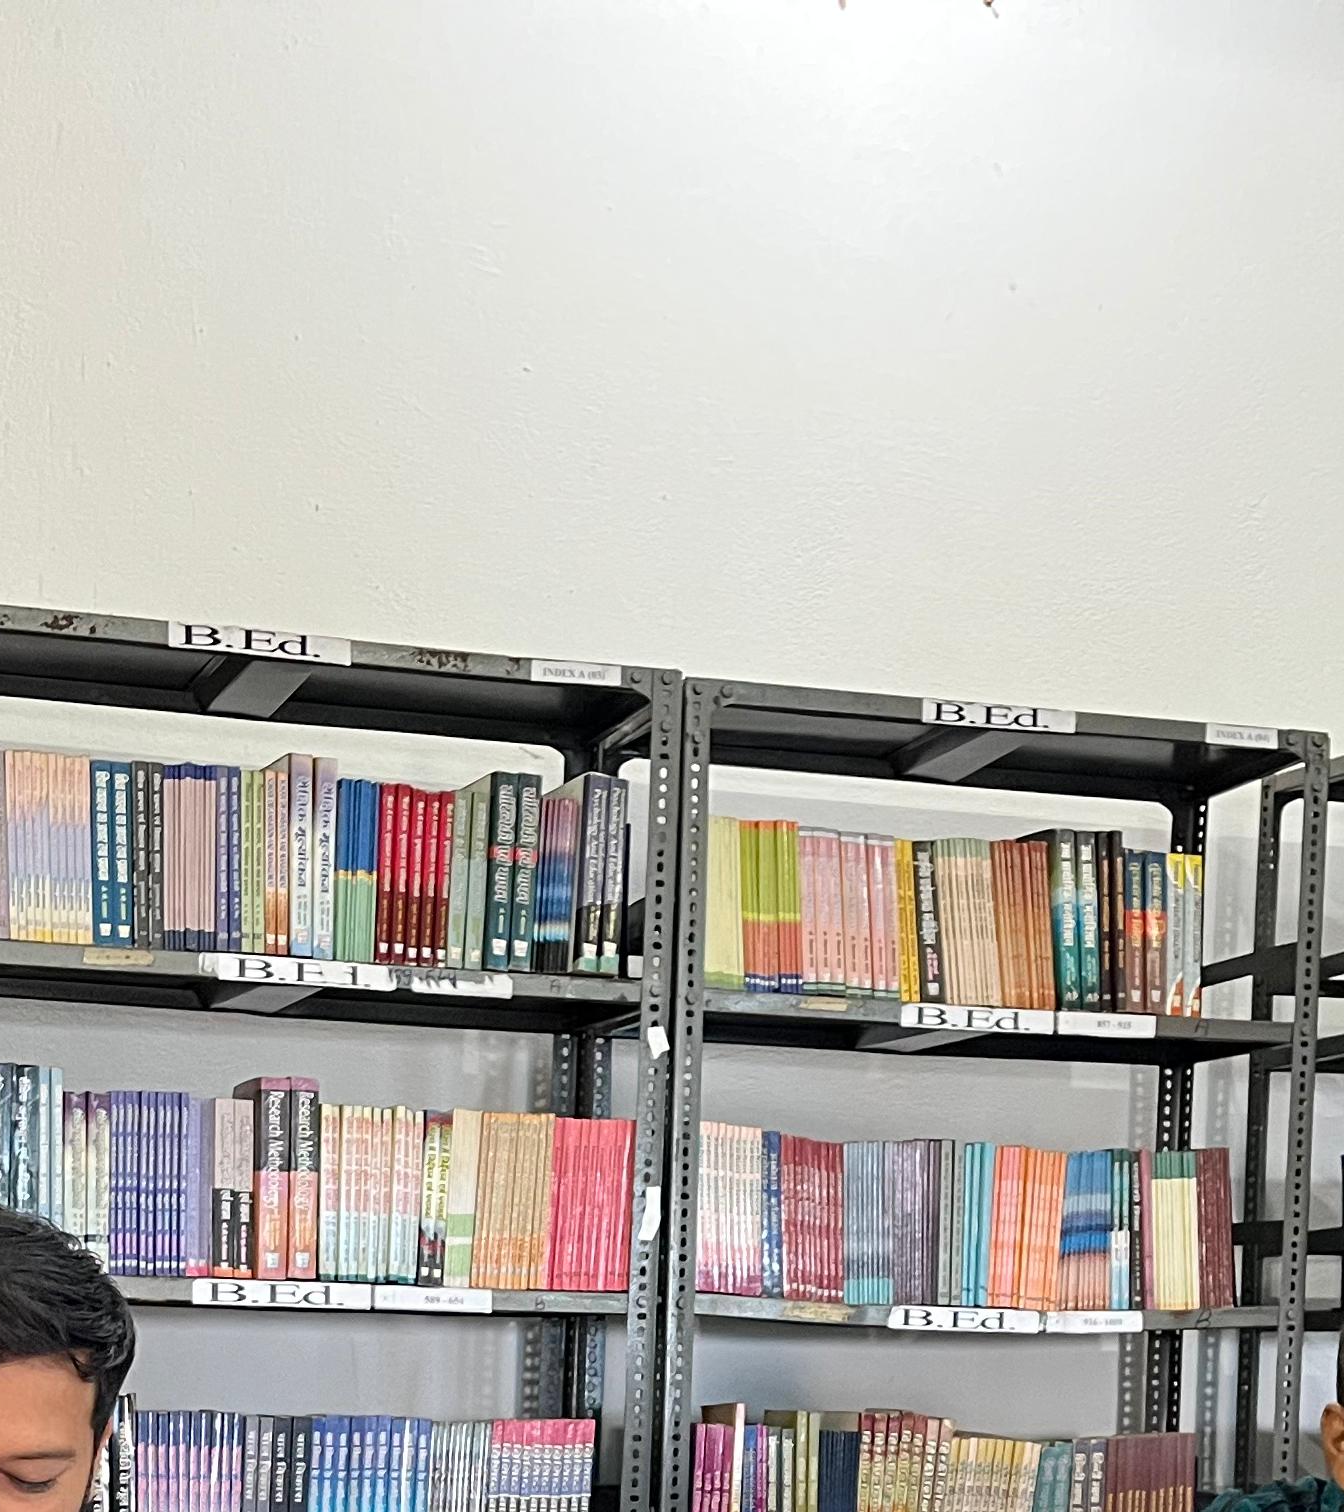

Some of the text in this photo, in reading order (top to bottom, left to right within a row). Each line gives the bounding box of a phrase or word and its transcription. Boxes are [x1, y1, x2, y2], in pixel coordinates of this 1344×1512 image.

[181, 626, 321, 658] B.Ed.
[542, 665, 577, 678] INDEX
[933, 701, 1049, 728] B.Ed.
[913, 1007, 1030, 1033] B.Ed.
[264, 1090, 284, 1210] Research Methodology
[296, 1091, 315, 1210] Research Methodology
[208, 1283, 344, 1308] B.Ed.
[896, 1308, 1015, 1331] B.Ed.
